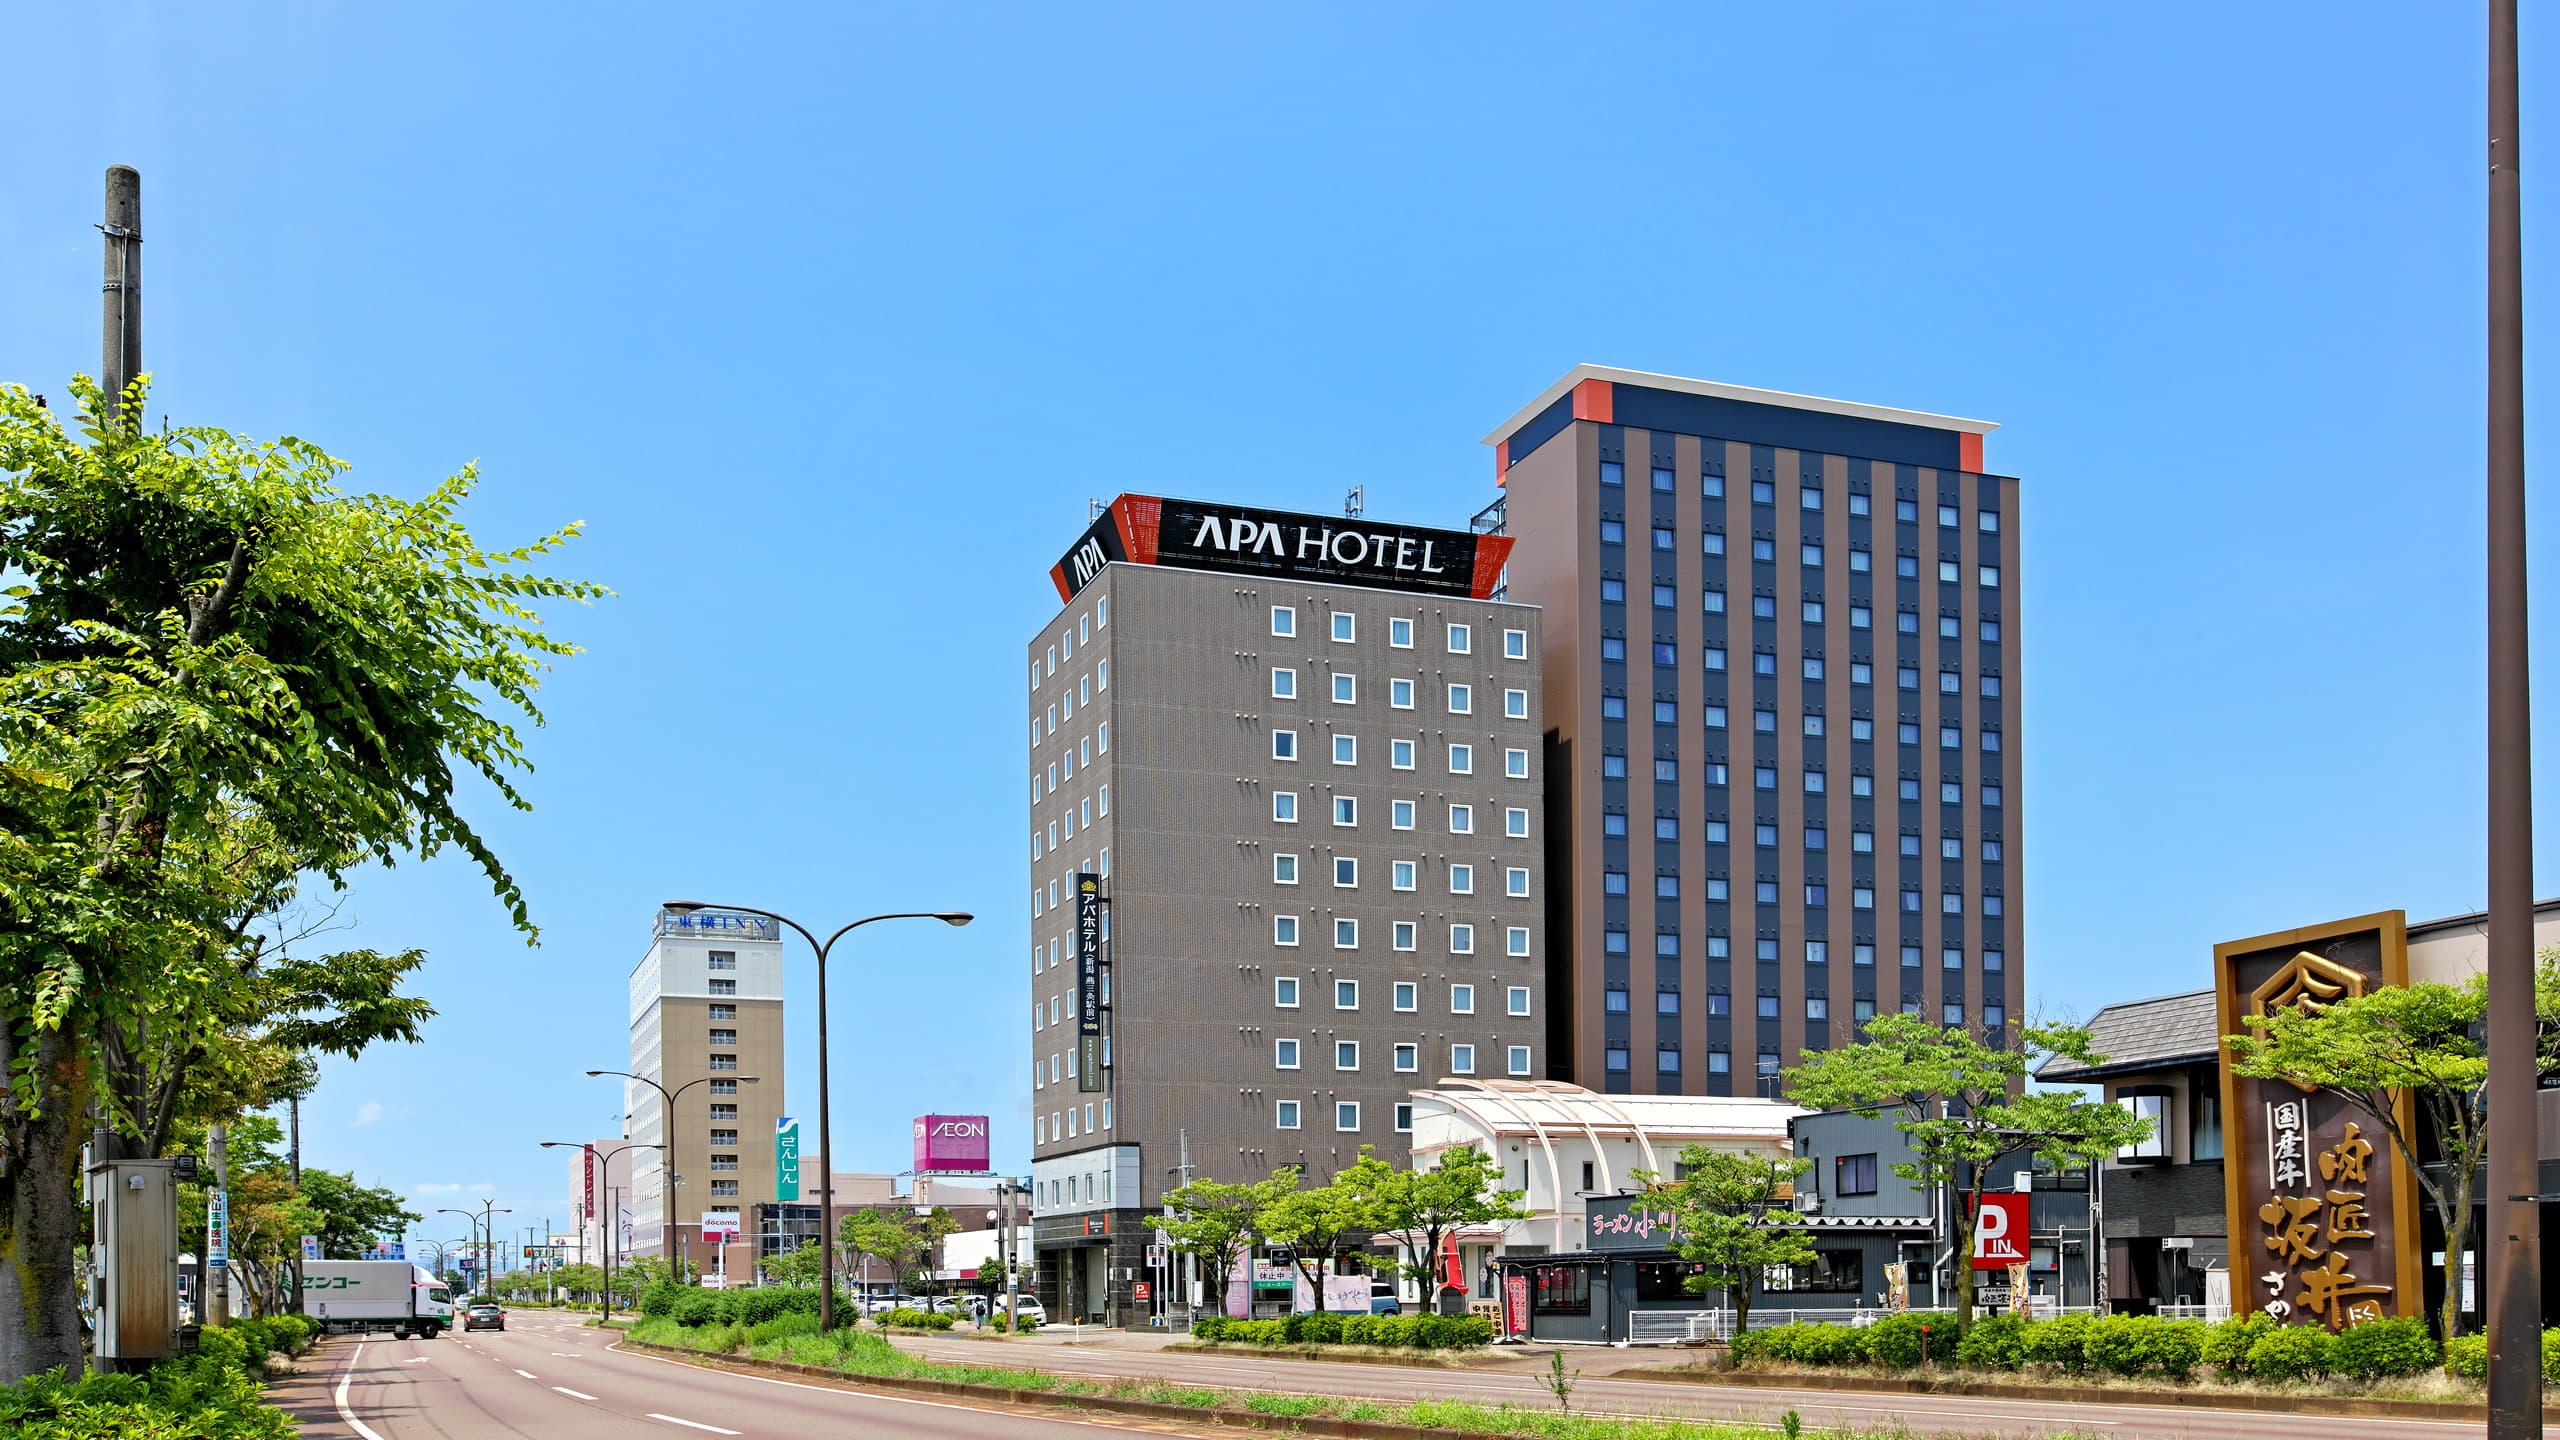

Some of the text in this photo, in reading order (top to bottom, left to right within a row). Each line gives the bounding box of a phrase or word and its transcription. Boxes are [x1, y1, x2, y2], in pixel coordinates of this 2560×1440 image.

[1073, 536, 1106, 589] APA
[1193, 516, 1444, 573] APA HOTEL
[1082, 893, 1096, 952] アパホテル
[781, 1137, 797, 1184] さんしん
[2273, 1101, 2304, 1188] 国産牛
[704, 1218, 738, 1226] docomo
[1593, 1214, 1632, 1235] ラーメン
[1974, 1205, 2008, 1258] P
[1993, 1240, 2011, 1253] IN
[302, 1277, 361, 1289] センコー
[1136, 1284, 1145, 1294] P
